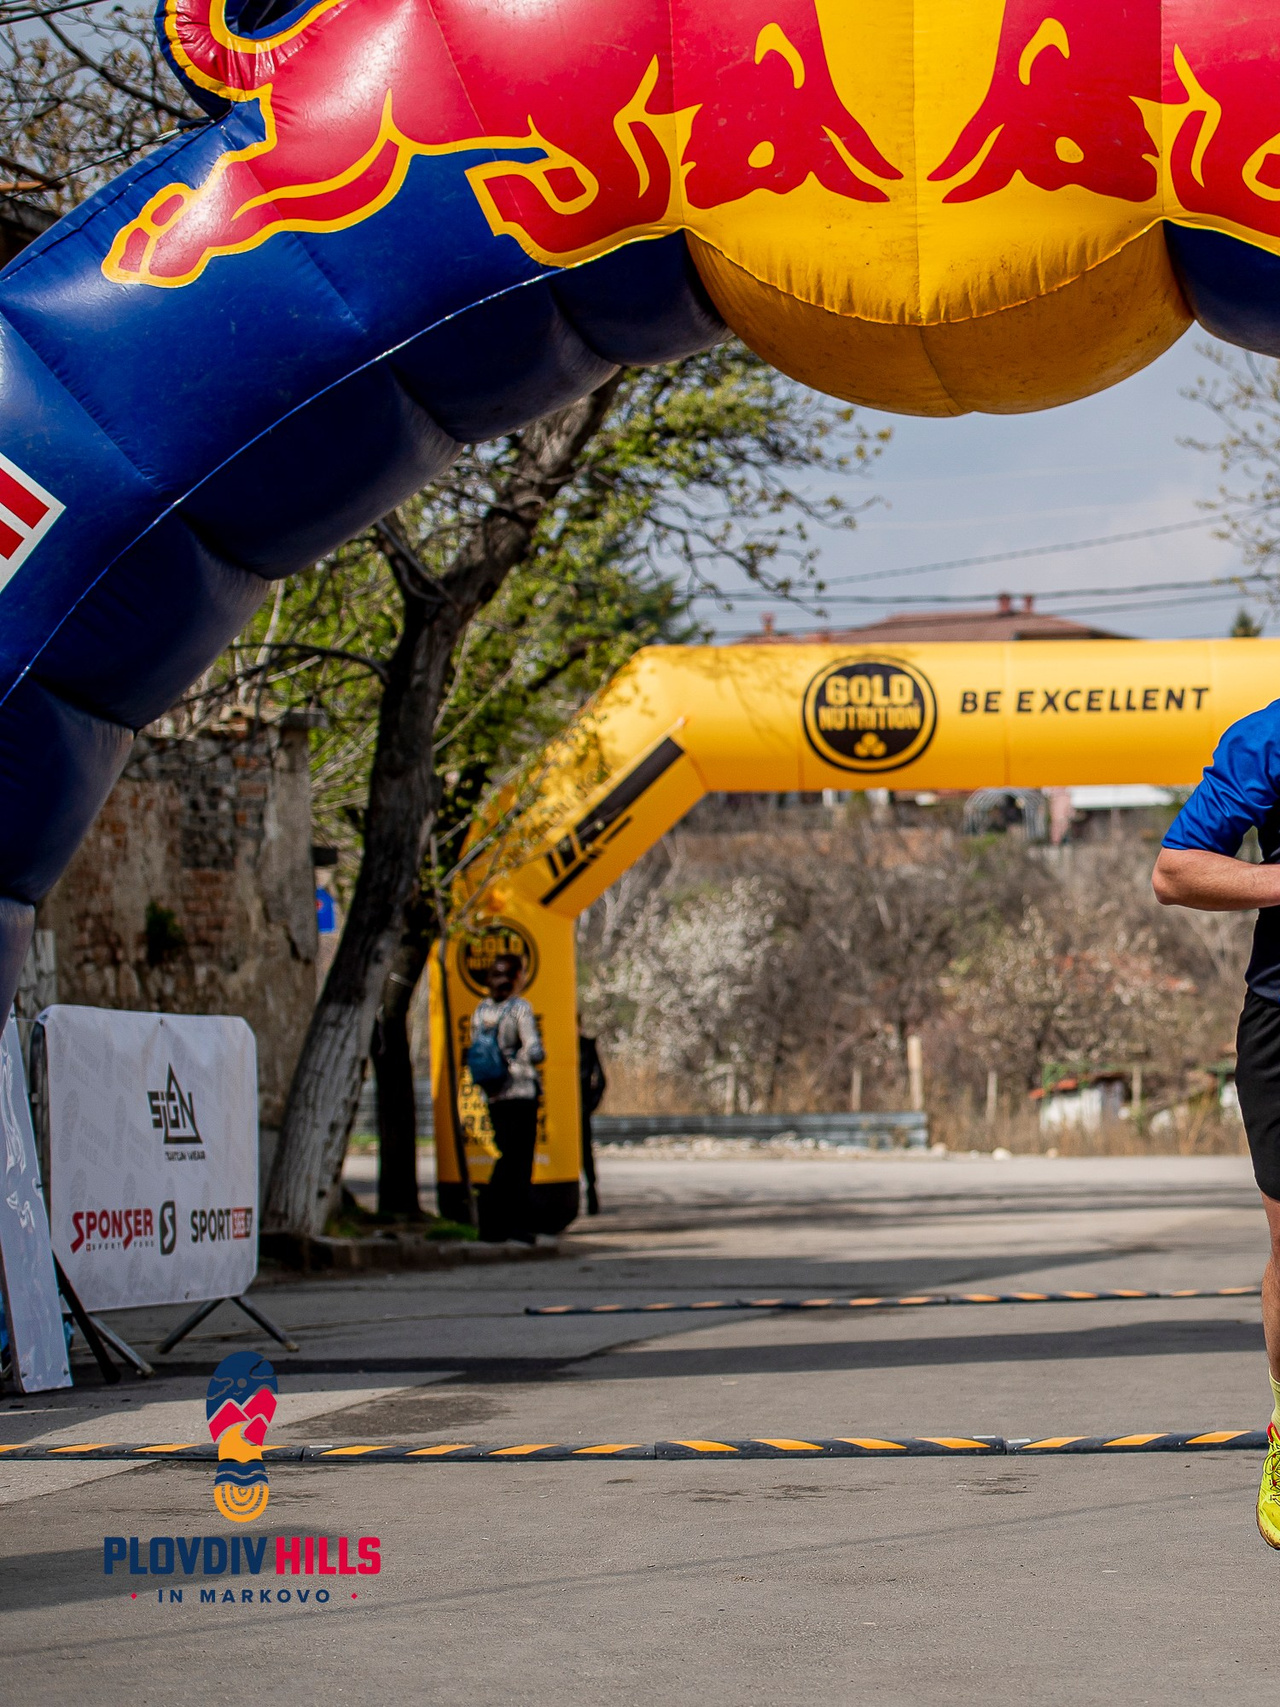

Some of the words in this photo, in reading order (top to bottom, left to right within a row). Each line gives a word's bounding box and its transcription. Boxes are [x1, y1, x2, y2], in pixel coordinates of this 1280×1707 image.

[825, 673, 915, 704] GOLD
[961, 690, 1001, 714] BE
[1016, 687, 1211, 714] EXCELLENT
[818, 704, 922, 732] NUTRITION
[70, 1207, 154, 1254] SPONSER
